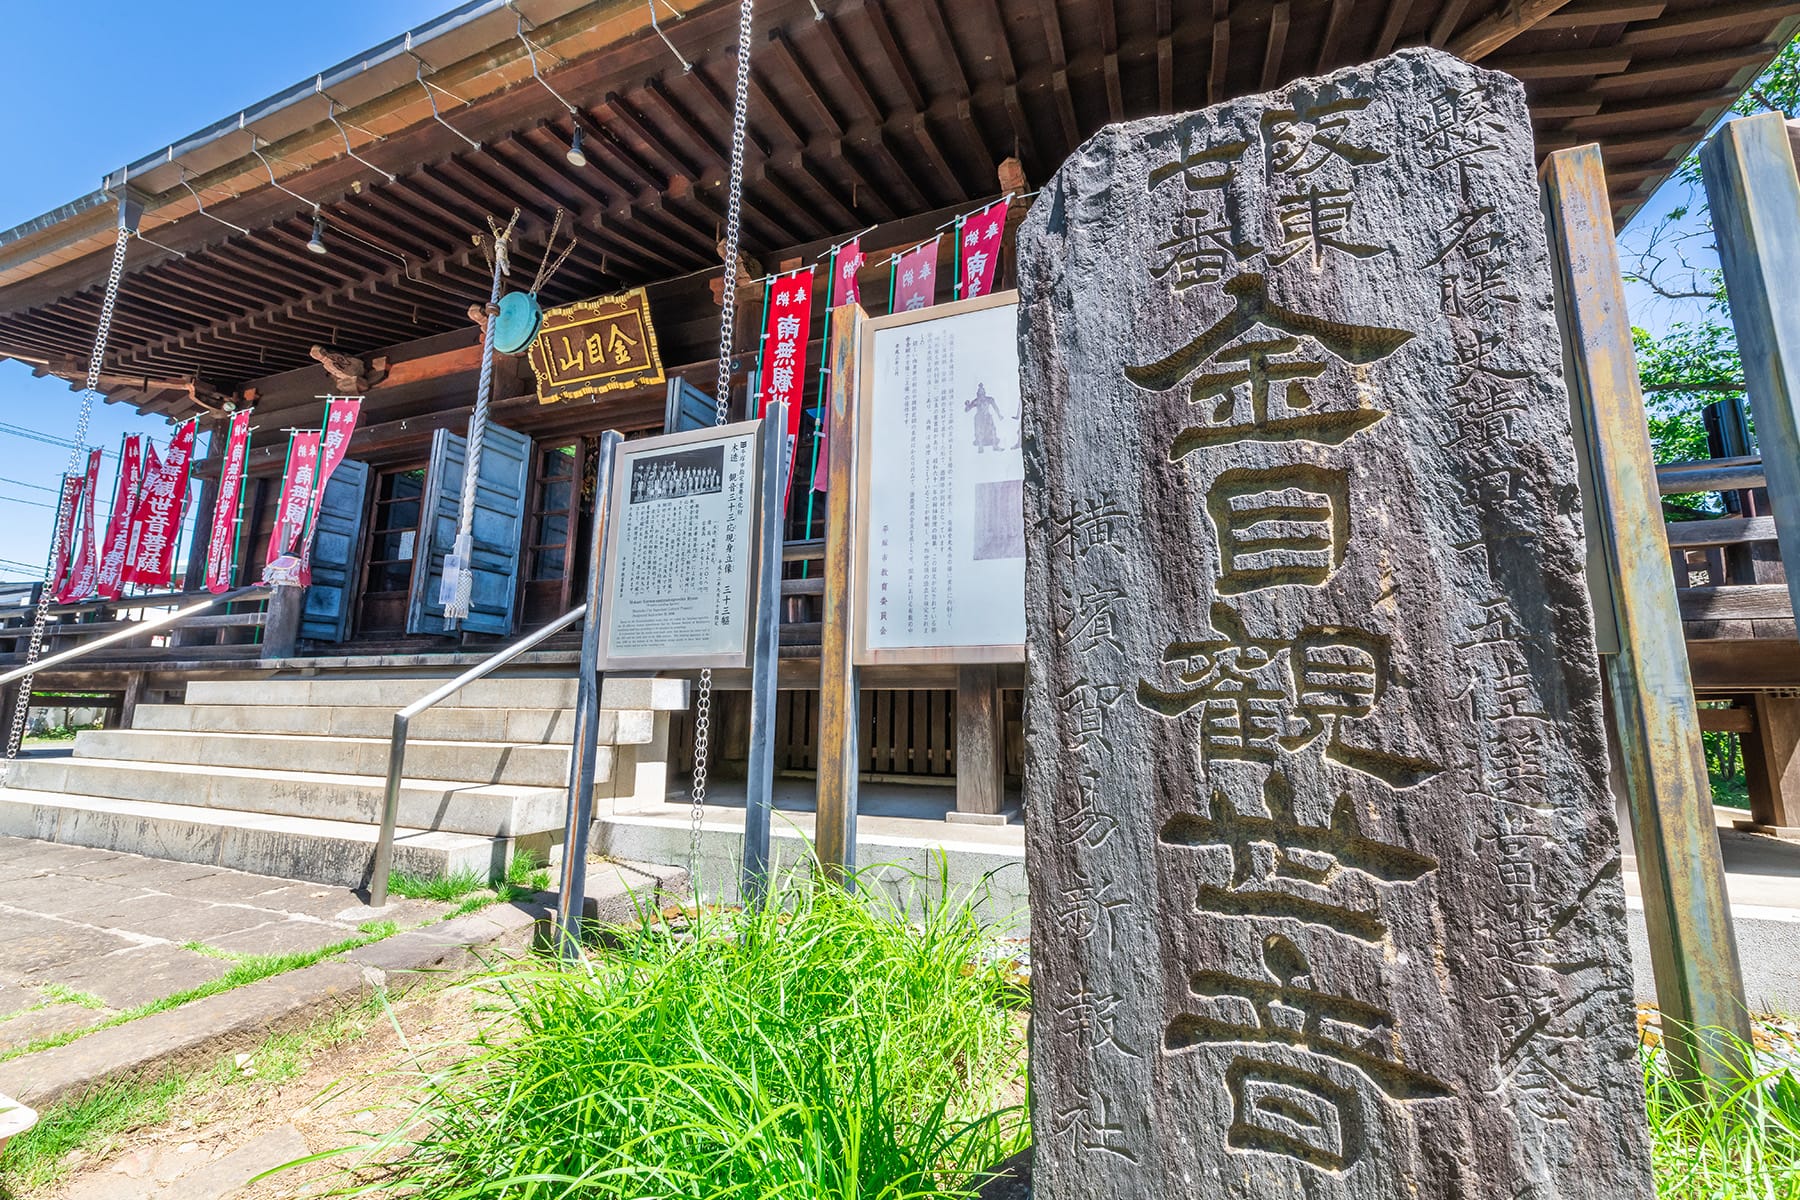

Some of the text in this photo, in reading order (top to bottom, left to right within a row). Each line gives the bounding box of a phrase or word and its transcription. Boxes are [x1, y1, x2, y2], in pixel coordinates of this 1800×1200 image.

[559, 323, 638, 372] 金目山
[730, 443, 739, 463] 木造
[135, 447, 187, 575] 南無観世音菩薩
